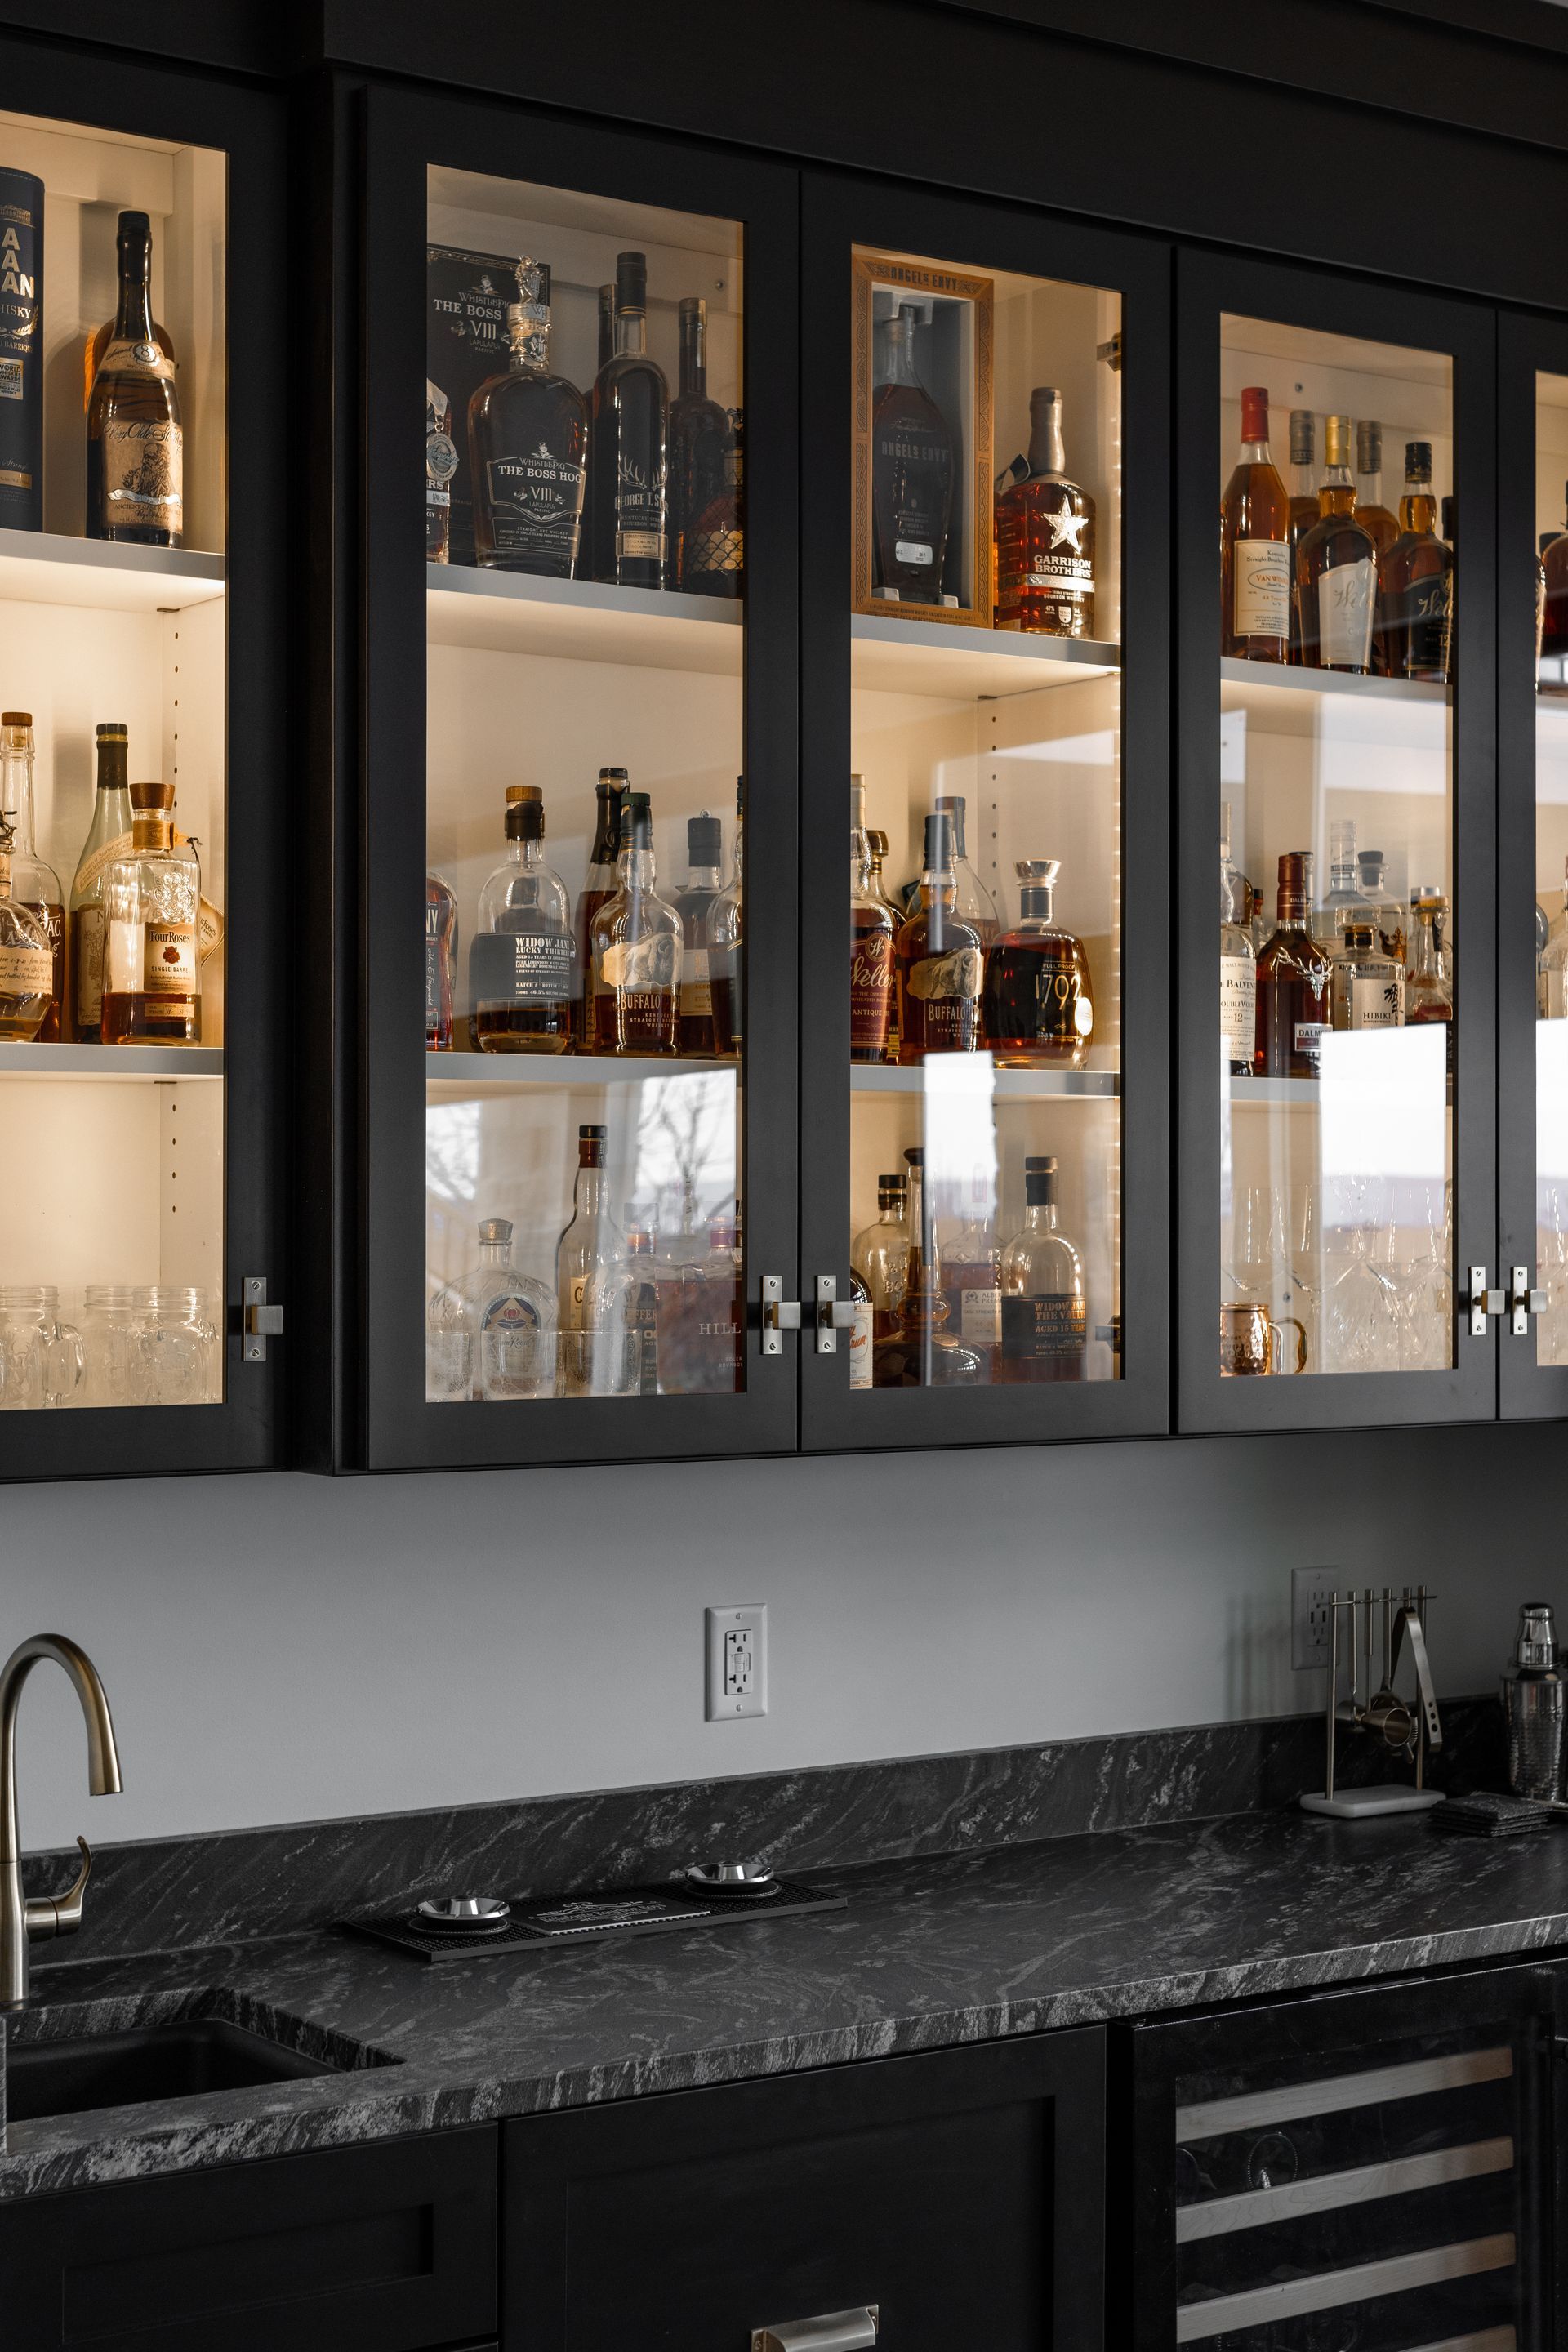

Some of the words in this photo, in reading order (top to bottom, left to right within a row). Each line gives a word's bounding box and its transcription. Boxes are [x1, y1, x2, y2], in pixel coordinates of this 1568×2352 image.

[433, 299, 463, 314] THE
[466, 304, 502, 321] BOSS
[470, 320, 497, 340] VIII
[140, 344, 150, 358] 8
[498, 466, 523, 476] THE
[527, 468, 556, 480] BOSS
[559, 471, 581, 483] HOG
[530, 486, 552, 501] VIII
[1034, 555, 1092, 570] GARRISON
[1035, 564, 1092, 578] BROTHERS
[150, 931, 169, 942] Four
[169, 931, 190, 943] Roses
[515, 937, 553, 947] WIDOW
[1036, 973, 1081, 1010] 1792
[621, 991, 661, 1011] BUFFALO
[928, 1004, 966, 1021] BUFFALO
[1234, 1013, 1243, 1022] 12
[1363, 1012, 1391, 1020] HIBIKI
[1035, 1302, 1070, 1312] WIDOW
[1035, 1311, 1058, 1321] THE
[698, 1322, 742, 1335] HILL
[1035, 1325, 1058, 1333] AGED
